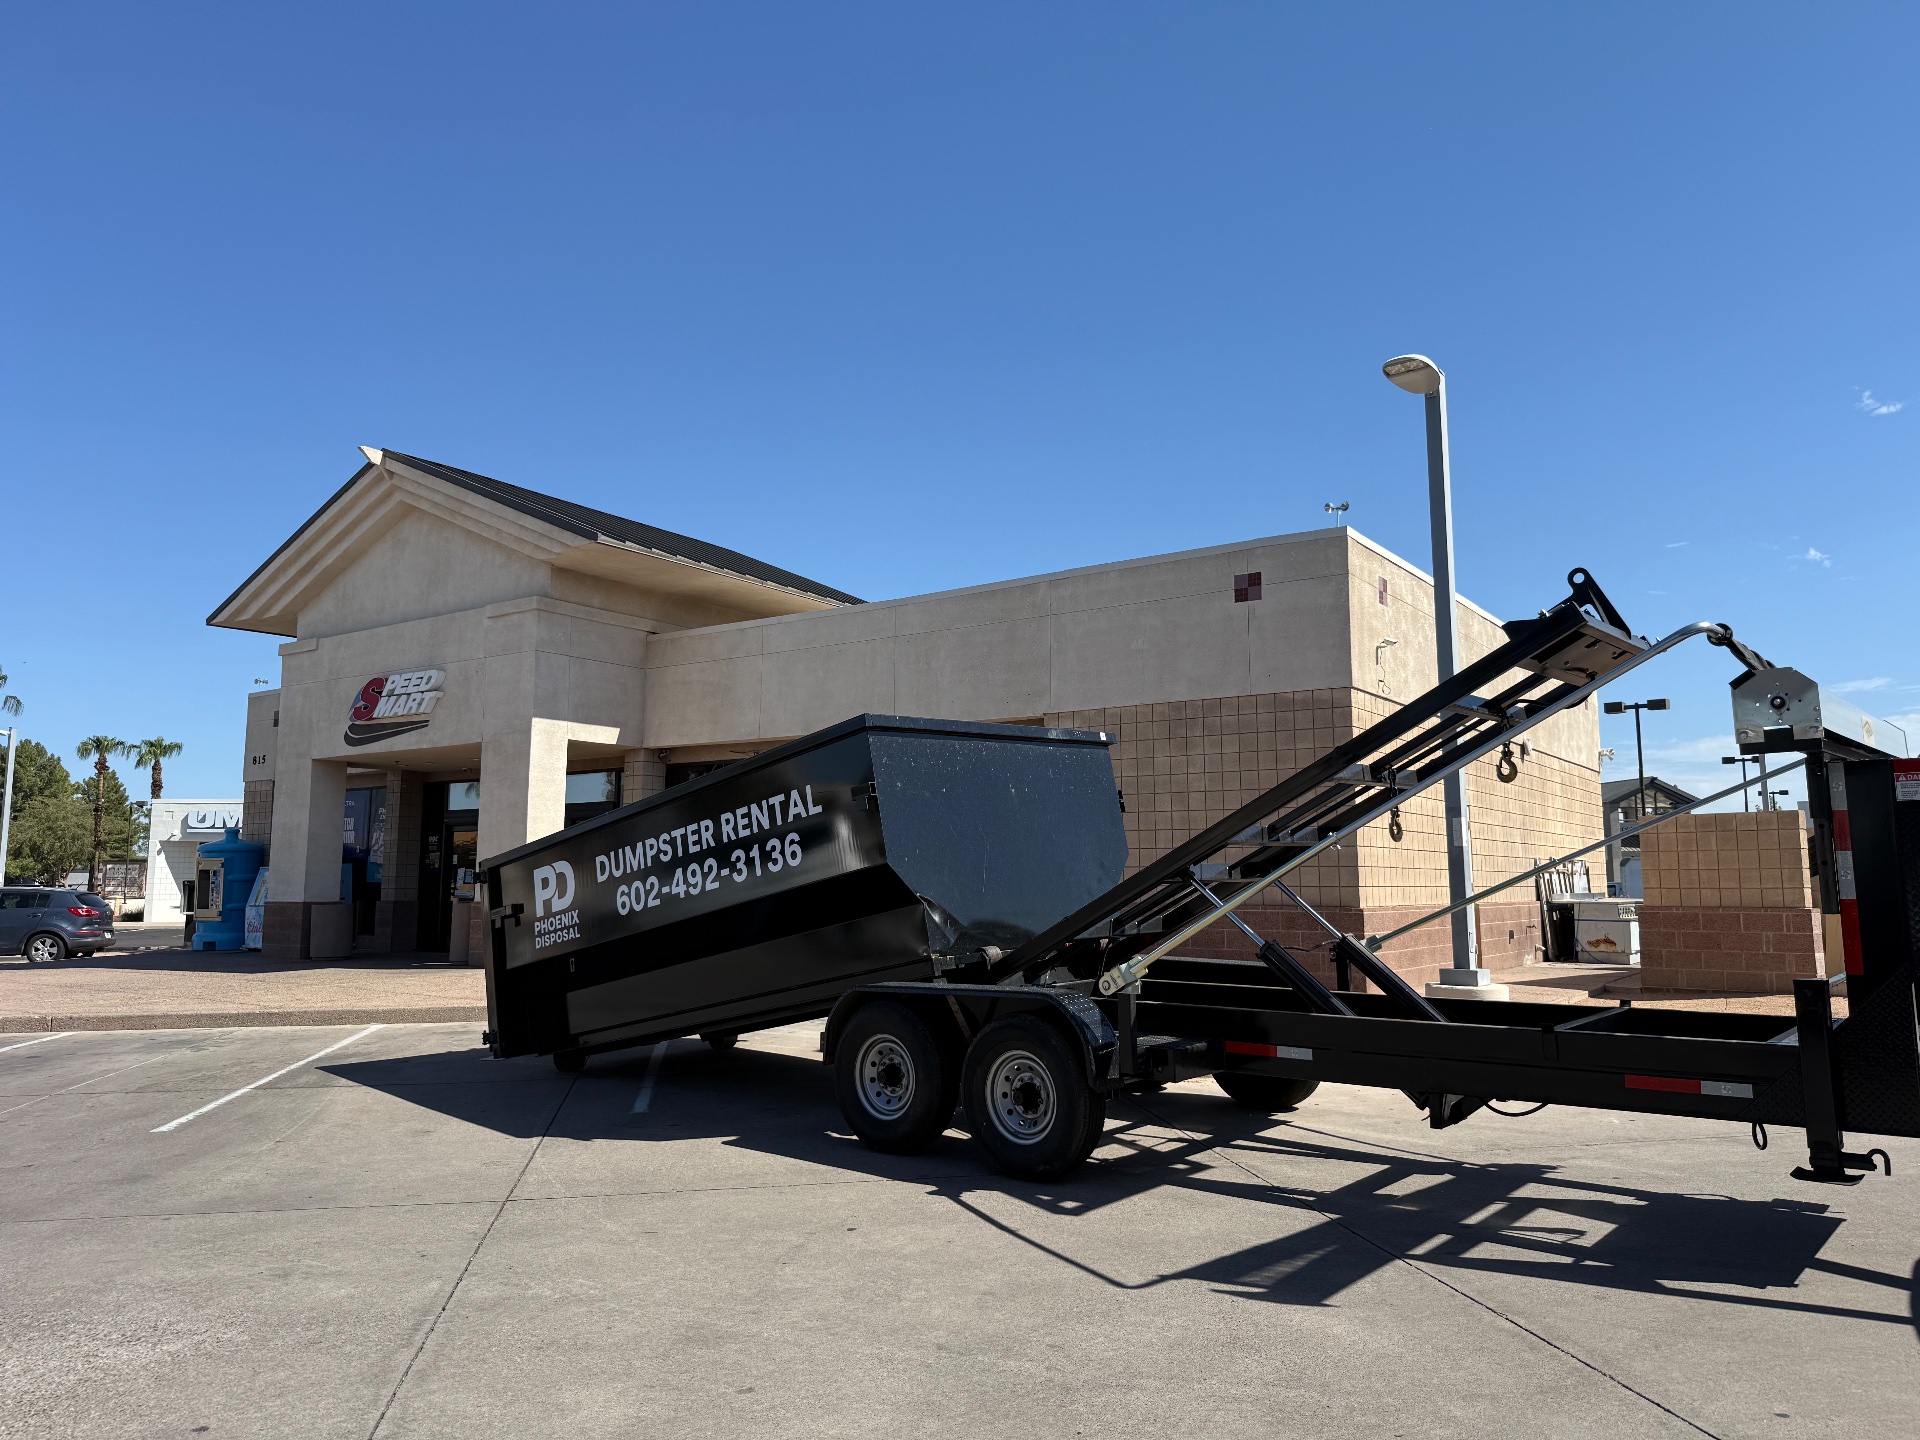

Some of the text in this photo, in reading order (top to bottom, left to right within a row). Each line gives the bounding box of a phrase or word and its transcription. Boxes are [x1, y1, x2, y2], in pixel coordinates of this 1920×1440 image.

[353, 669, 442, 721] SPEED
[252, 754, 267, 766] 815
[595, 784, 823, 883] DUMPSTER RENTAL
[533, 860, 576, 918] PD
[615, 831, 803, 916] 602-492-3136
[534, 909, 580, 936] PHOENIX
[535, 926, 581, 949] DISPOSAL
